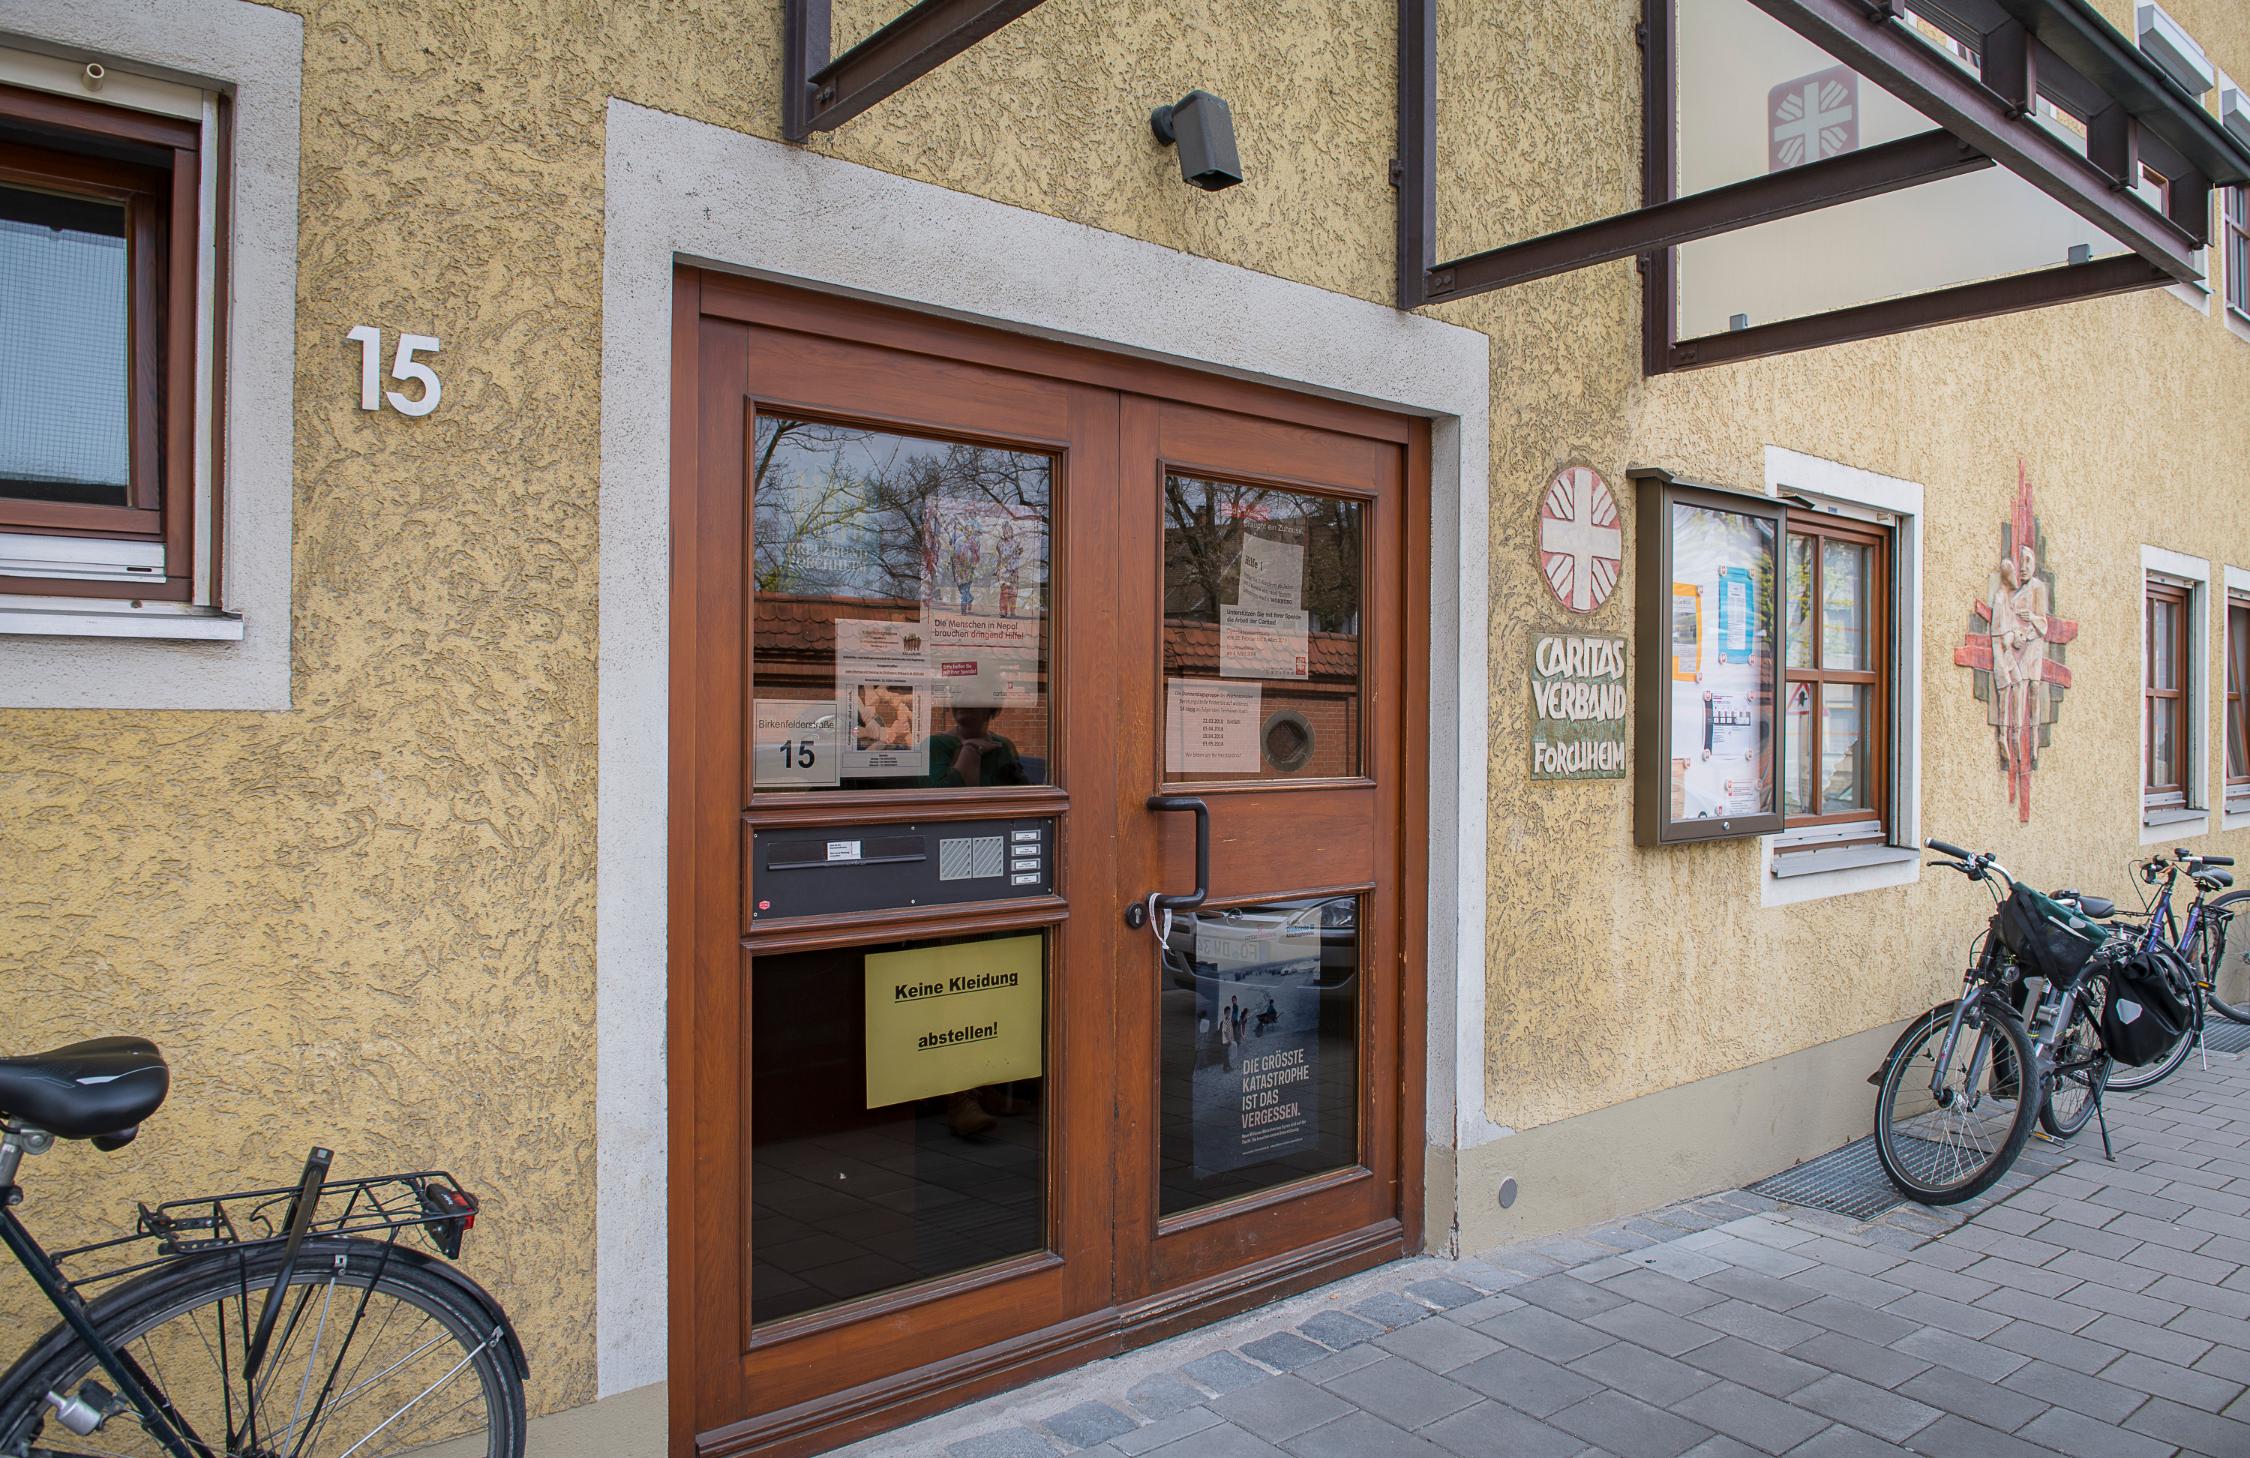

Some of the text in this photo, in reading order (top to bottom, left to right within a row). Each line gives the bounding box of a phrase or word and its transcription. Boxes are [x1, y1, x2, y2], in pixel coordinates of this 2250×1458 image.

[346, 325, 442, 416] 15
[934, 629, 1024, 640] brauchen dringend Hilfe!
[948, 620, 986, 630] Menschen
[996, 622, 1018, 630] Nepal
[1536, 637, 1625, 680] CARITAS
[1532, 681, 1627, 723] VERBAND
[758, 720, 834, 729] Birkenfelderstraße
[780, 740, 816, 768] 15
[895, 972, 1018, 1000] Keine Kleidung
[918, 1021, 998, 1048] abstellen!
[1243, 1048, 1304, 1075] DIE GRÖSSTE
[1242, 1065, 1310, 1094] KATASTROPHE
[1242, 1089, 1279, 1111] IST DAS
[1242, 1102, 1300, 1129] VERGESSEN.
